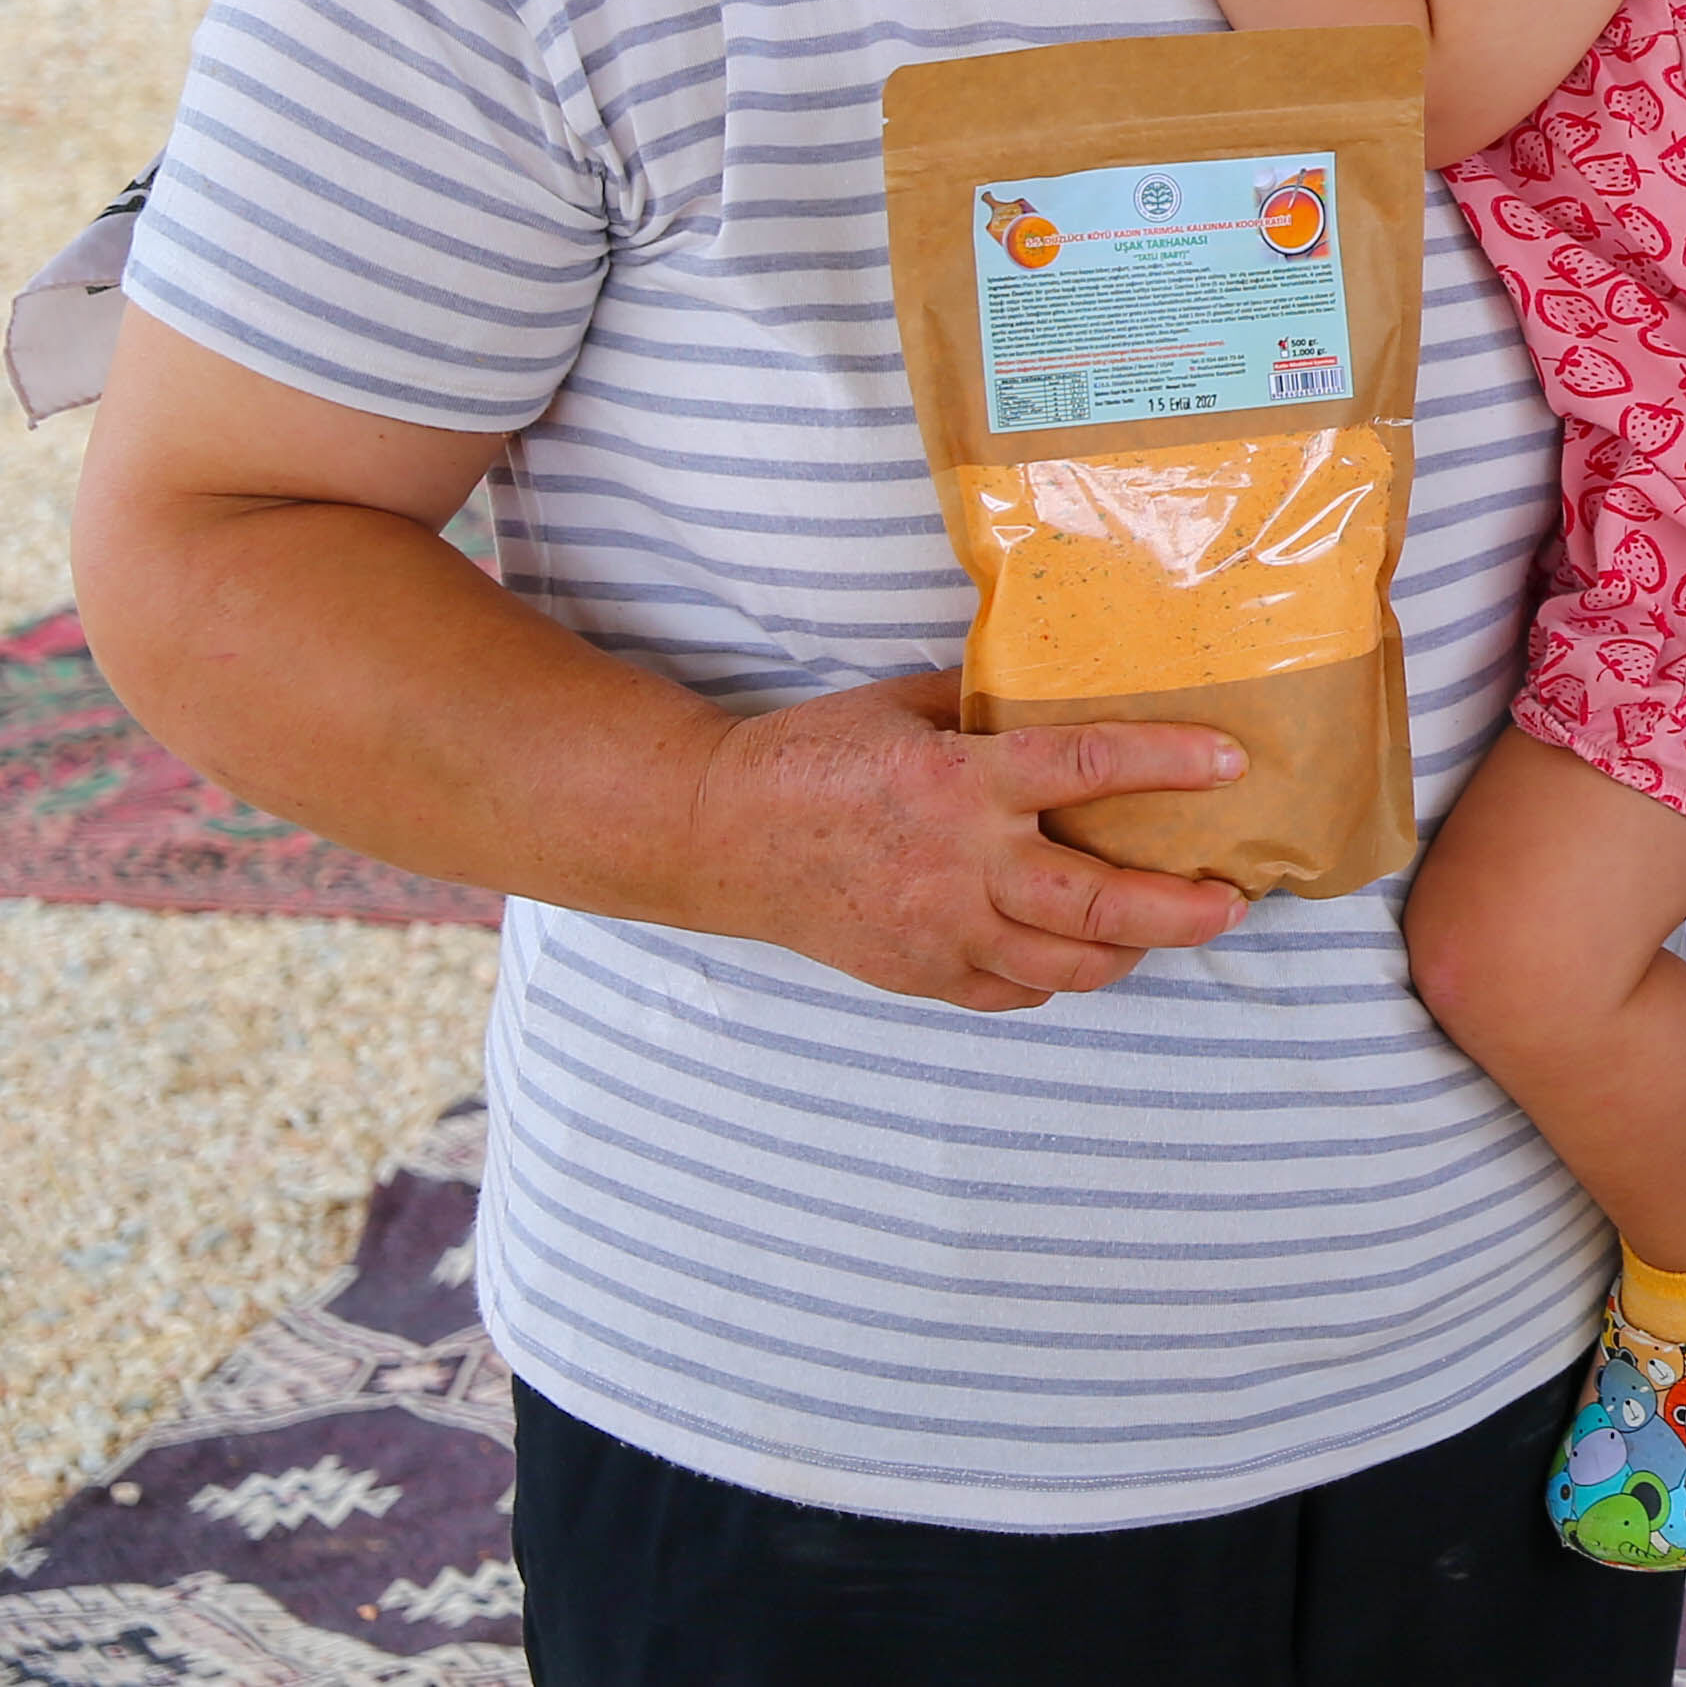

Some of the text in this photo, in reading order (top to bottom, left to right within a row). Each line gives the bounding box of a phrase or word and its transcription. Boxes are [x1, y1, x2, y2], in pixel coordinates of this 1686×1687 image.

[1088, 230, 1112, 241] KÖYÜ
[1114, 228, 1141, 238] KADIN
[1144, 224, 1184, 236] TARIMSAL
[1187, 220, 1233, 233] KALKINMA
[1115, 235, 1208, 253] UŞAK TARHANASI
[1291, 339, 1306, 347] 500
[1292, 347, 1315, 357] 1.000
